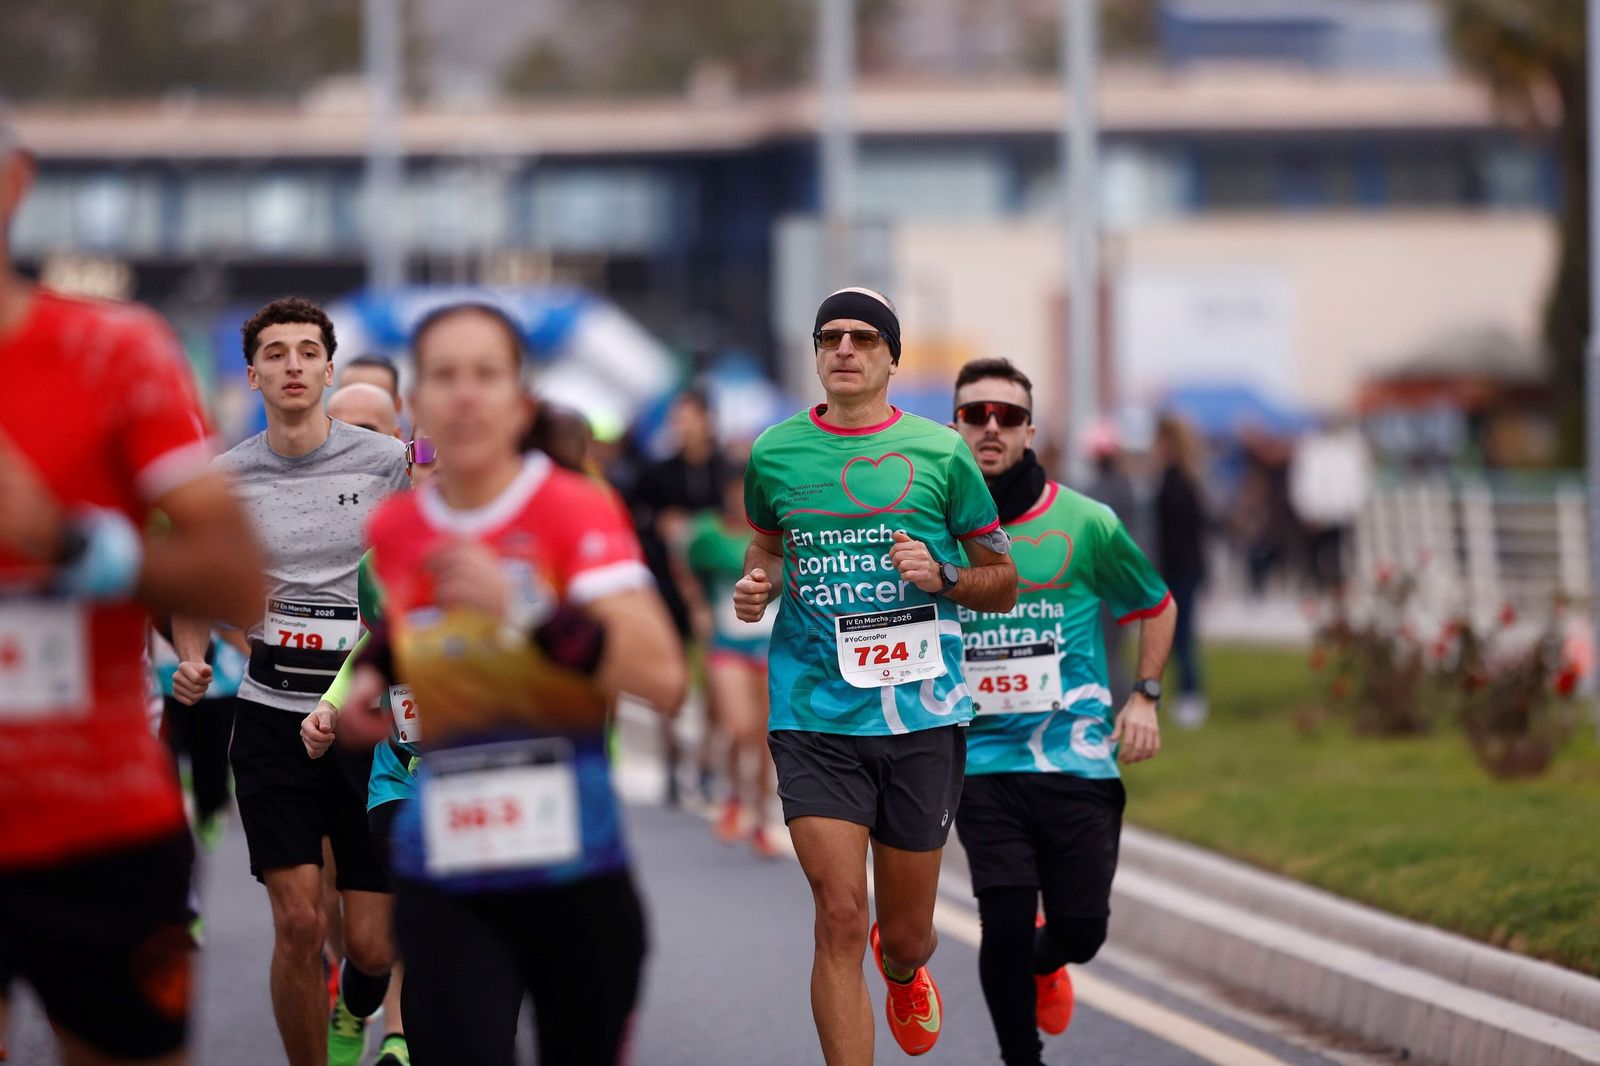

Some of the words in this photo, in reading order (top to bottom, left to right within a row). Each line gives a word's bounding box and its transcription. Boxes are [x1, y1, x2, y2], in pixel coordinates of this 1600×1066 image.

[791, 528, 814, 546] En
[820, 523, 907, 545] march
[798, 550, 877, 575] contra
[880, 552, 895, 571] e
[799, 576, 910, 606] cáncer
[288, 604, 312, 613] Marcha
[314, 608, 335, 617] 2026
[864, 615, 889, 624] Marcha
[892, 612, 912, 623] 2026
[278, 629, 323, 650] 719
[844, 633, 888, 643] #YoCorroPor
[854, 641, 909, 666] 724
[978, 673, 1029, 693] 453
[402, 699, 416, 719] 2
